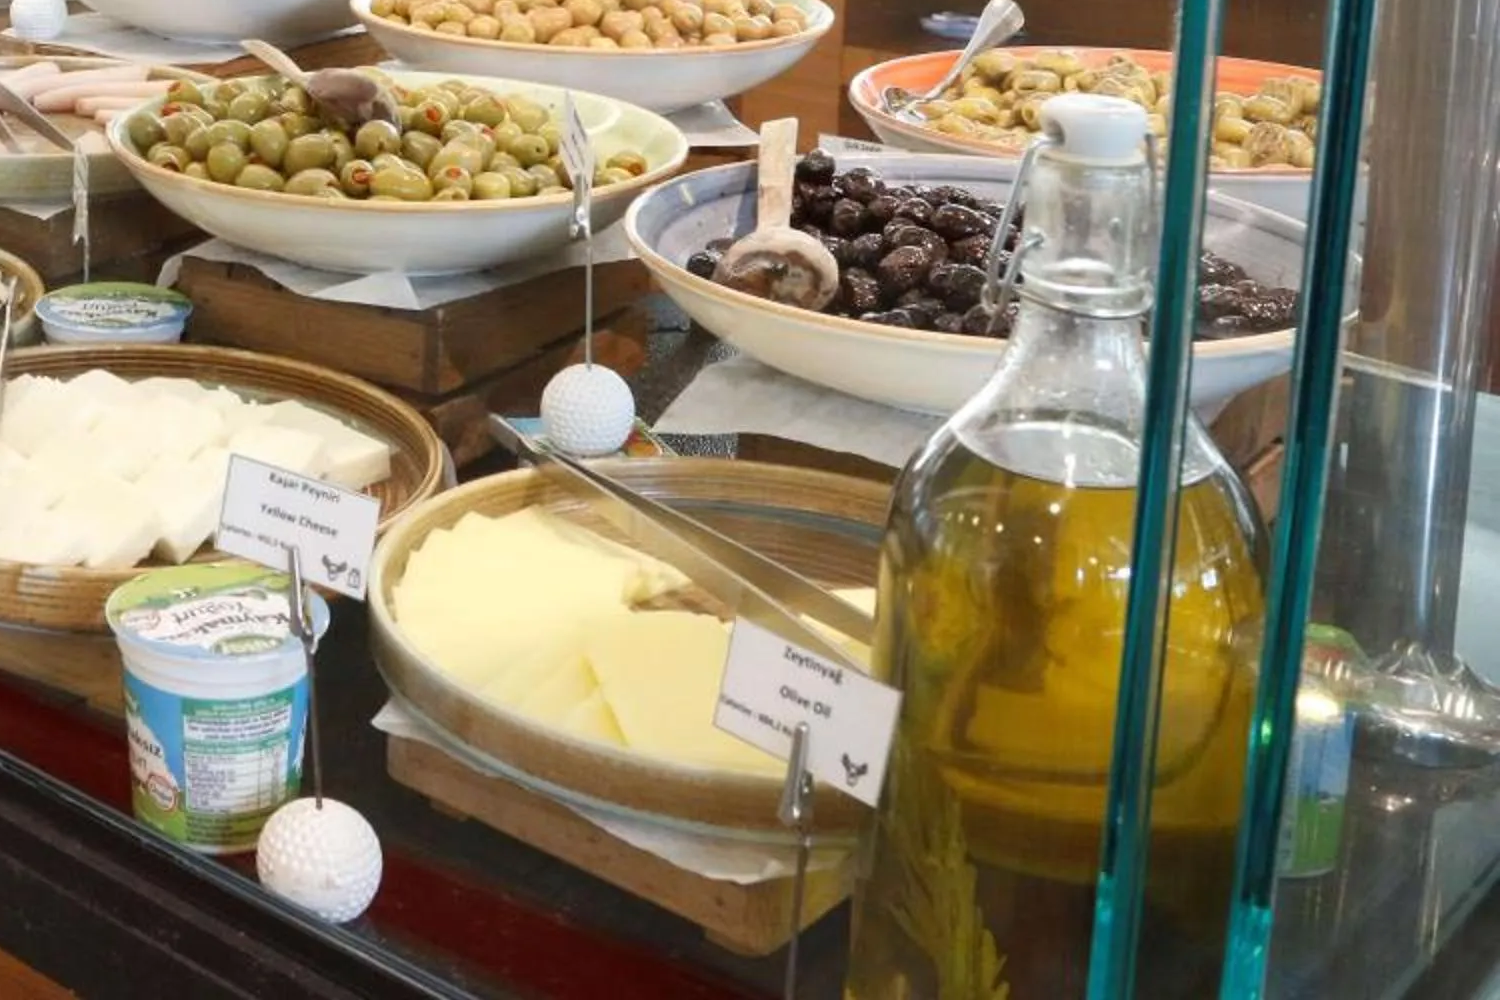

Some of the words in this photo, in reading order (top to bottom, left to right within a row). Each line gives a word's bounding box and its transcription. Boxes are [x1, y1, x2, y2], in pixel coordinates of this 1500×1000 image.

[260, 503, 296, 523] Yellow
[299, 514, 338, 537] Cheese
[780, 685, 810, 709] Olive
[813, 701, 832, 719] Oil
